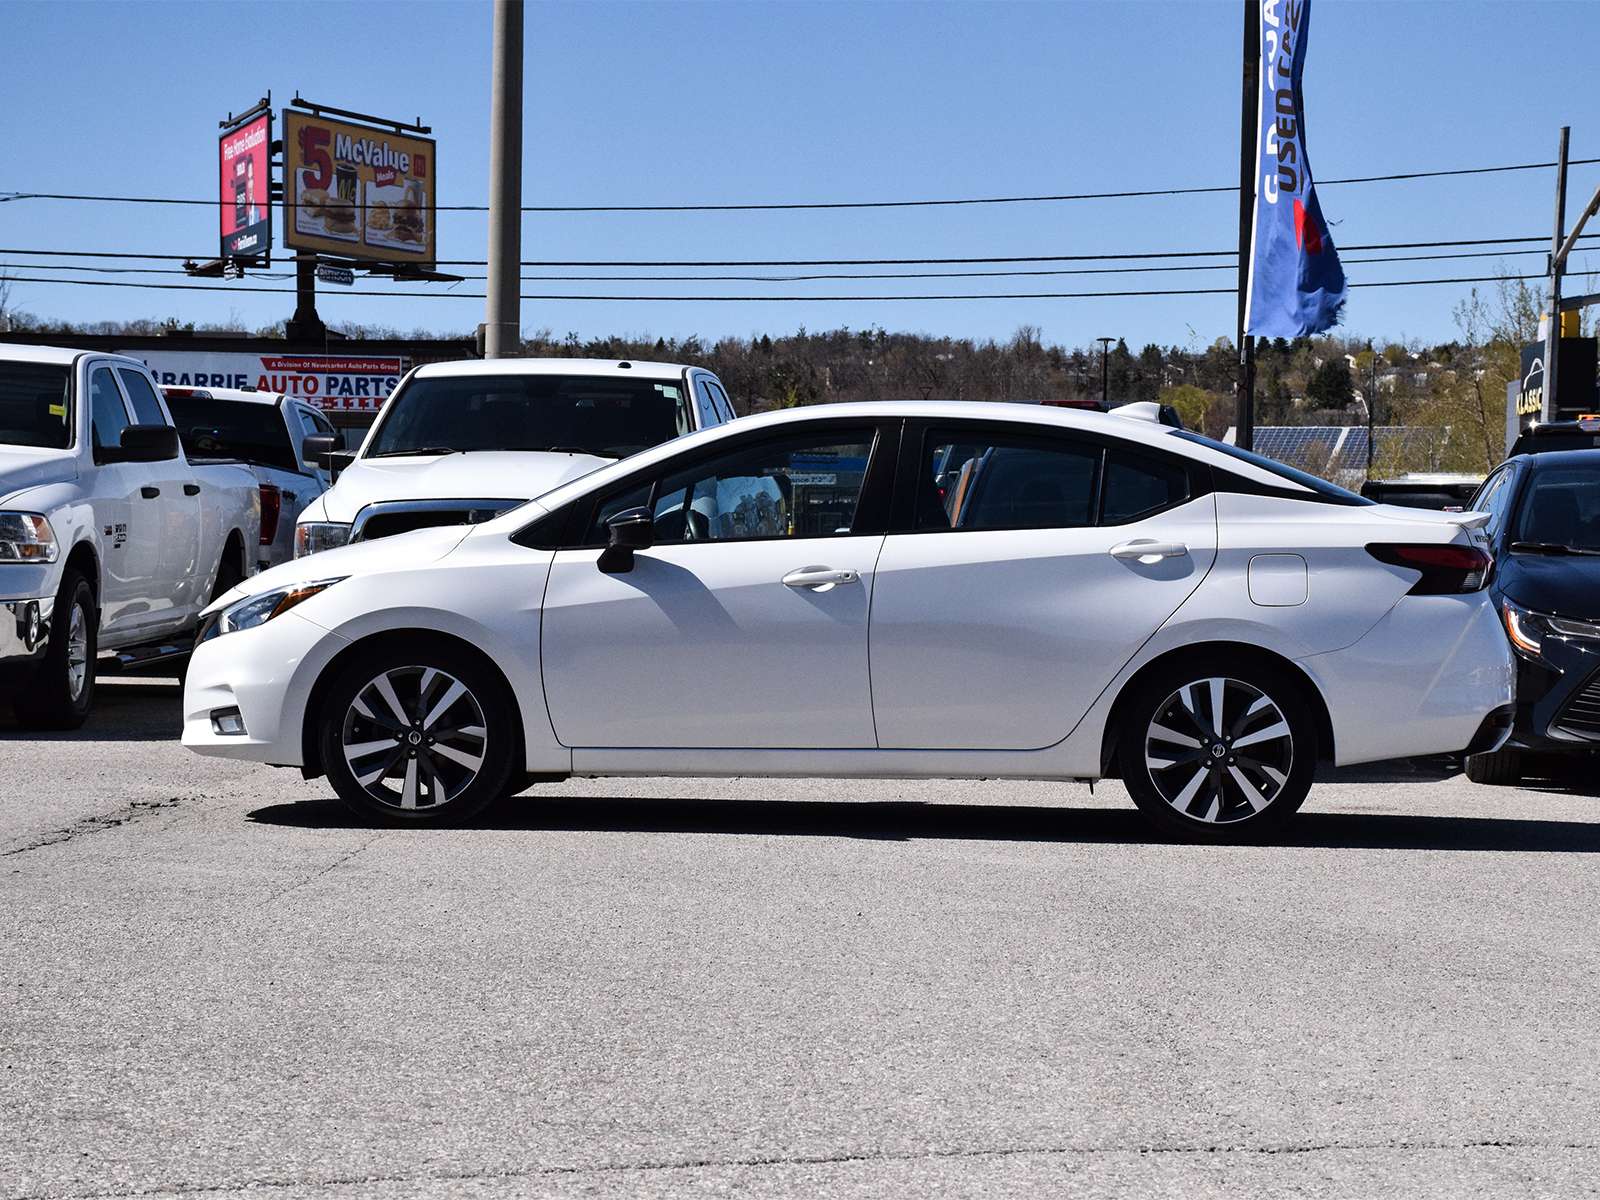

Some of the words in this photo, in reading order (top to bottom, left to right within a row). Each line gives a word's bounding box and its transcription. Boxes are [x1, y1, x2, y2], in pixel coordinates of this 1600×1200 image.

[335, 133, 410, 173] McValue
[1275, 88, 1297, 193] USED
[311, 361, 347, 369] Newmarket
[380, 363, 398, 371] Group
[162, 372, 248, 389] BARRIE
[256, 375, 319, 394] AUTO
[325, 376, 398, 396] PARTS
[1515, 387, 1542, 416] KLASSIC
